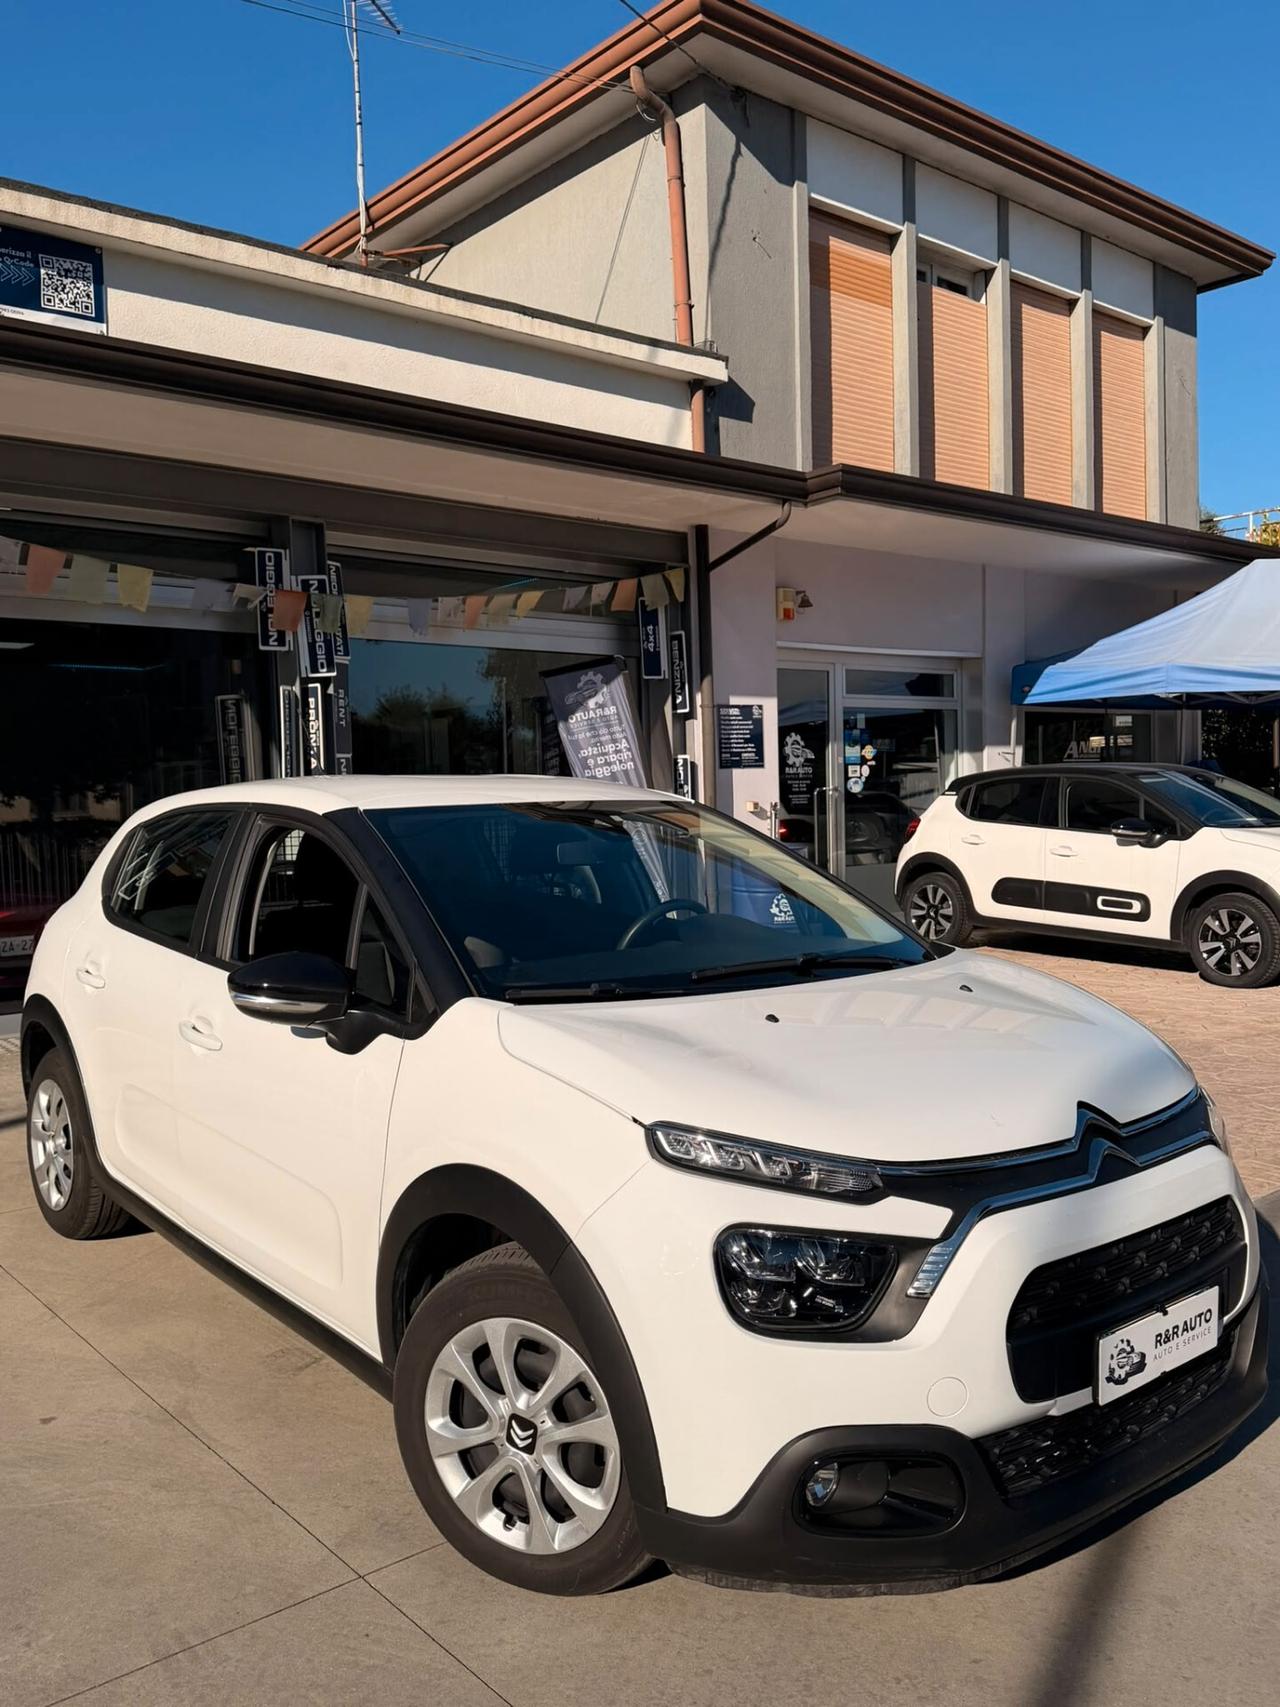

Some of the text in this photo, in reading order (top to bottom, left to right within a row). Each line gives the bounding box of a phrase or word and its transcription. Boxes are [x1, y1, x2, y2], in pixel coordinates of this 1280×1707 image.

[671, 639, 682, 704] BENZINA
[338, 689, 346, 728] RENT
[1153, 1326, 1212, 1361] AUTO E SERVICE
